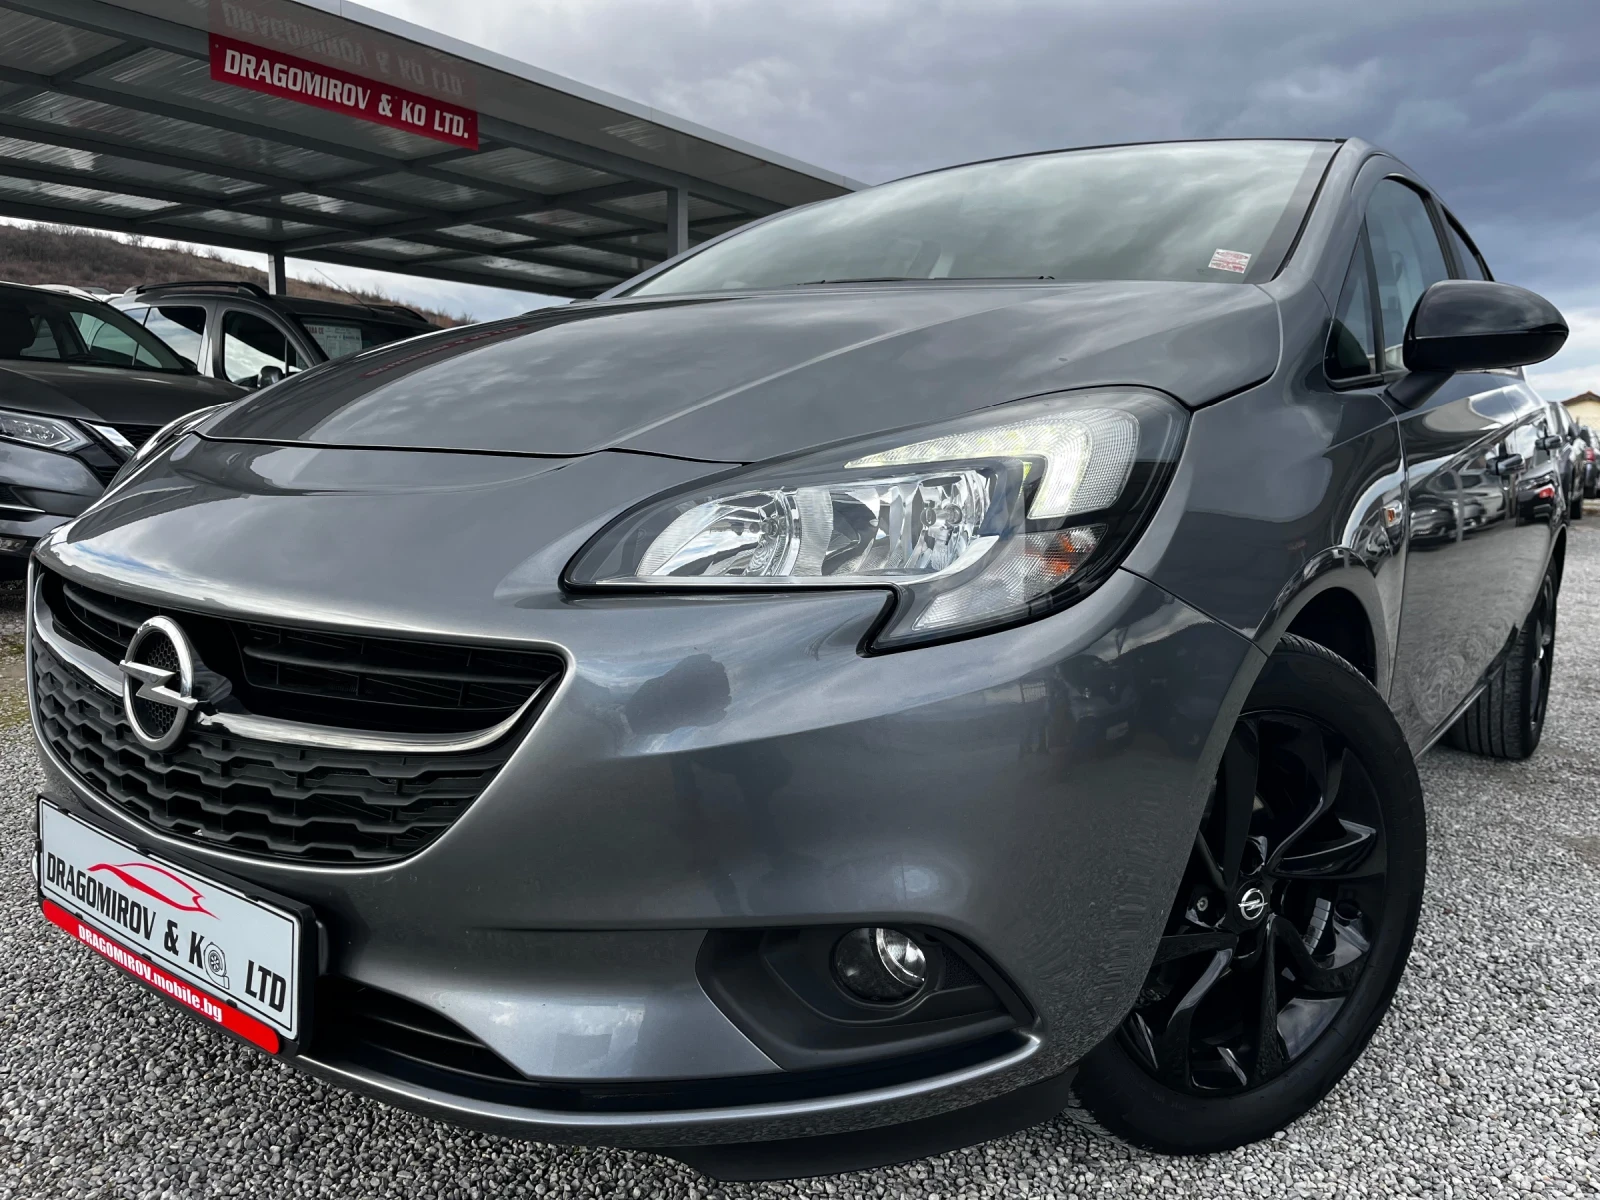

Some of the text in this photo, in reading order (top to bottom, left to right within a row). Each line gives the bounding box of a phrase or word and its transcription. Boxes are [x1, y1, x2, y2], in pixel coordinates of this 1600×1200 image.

[223, 48, 469, 139] DRAGOMIROV & KO LTD.
[46, 851, 157, 941] DRAGOMIROV
[163, 919, 180, 956] &
[244, 959, 287, 1013] LTD
[78, 923, 223, 1024] DRAGOMIROV.mobile.bg
